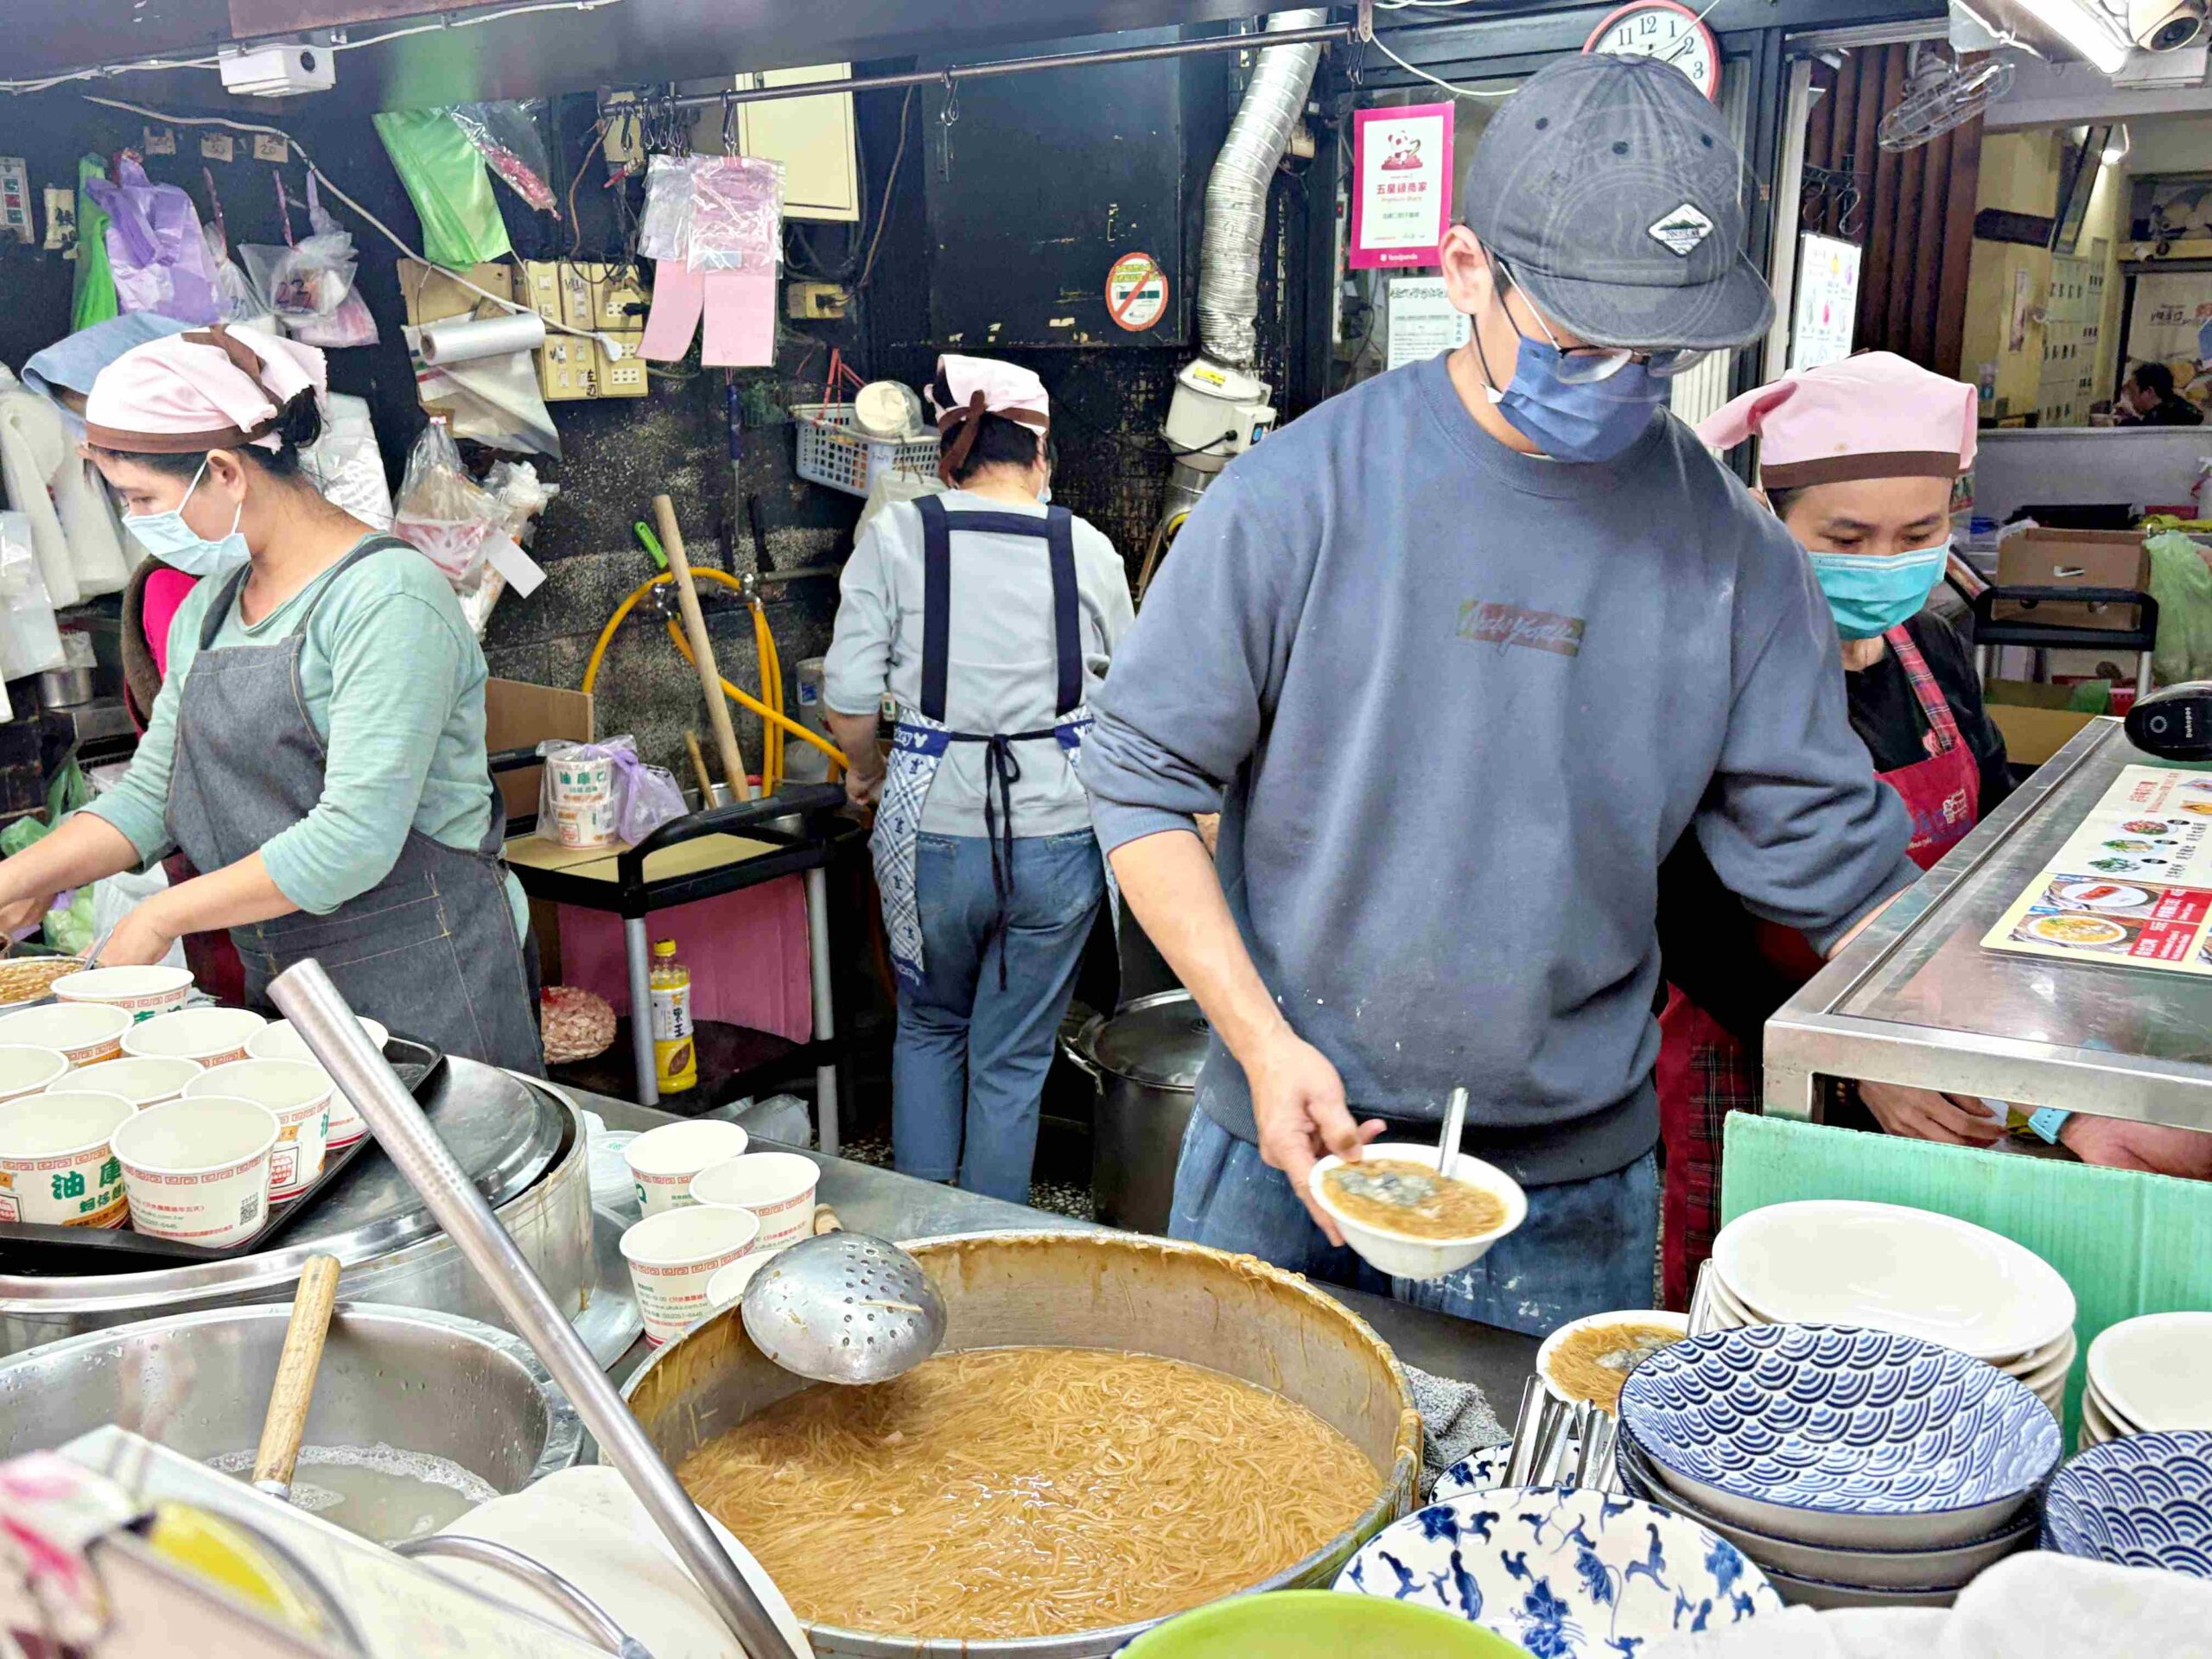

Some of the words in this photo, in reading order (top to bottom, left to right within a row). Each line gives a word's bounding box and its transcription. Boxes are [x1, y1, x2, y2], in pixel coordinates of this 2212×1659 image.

[1640, 15, 1657, 35] 12
[1669, 19, 1677, 38] 1
[1618, 27, 1633, 47] 11
[1682, 35, 1694, 55] 2
[1693, 60, 1704, 79] 3
